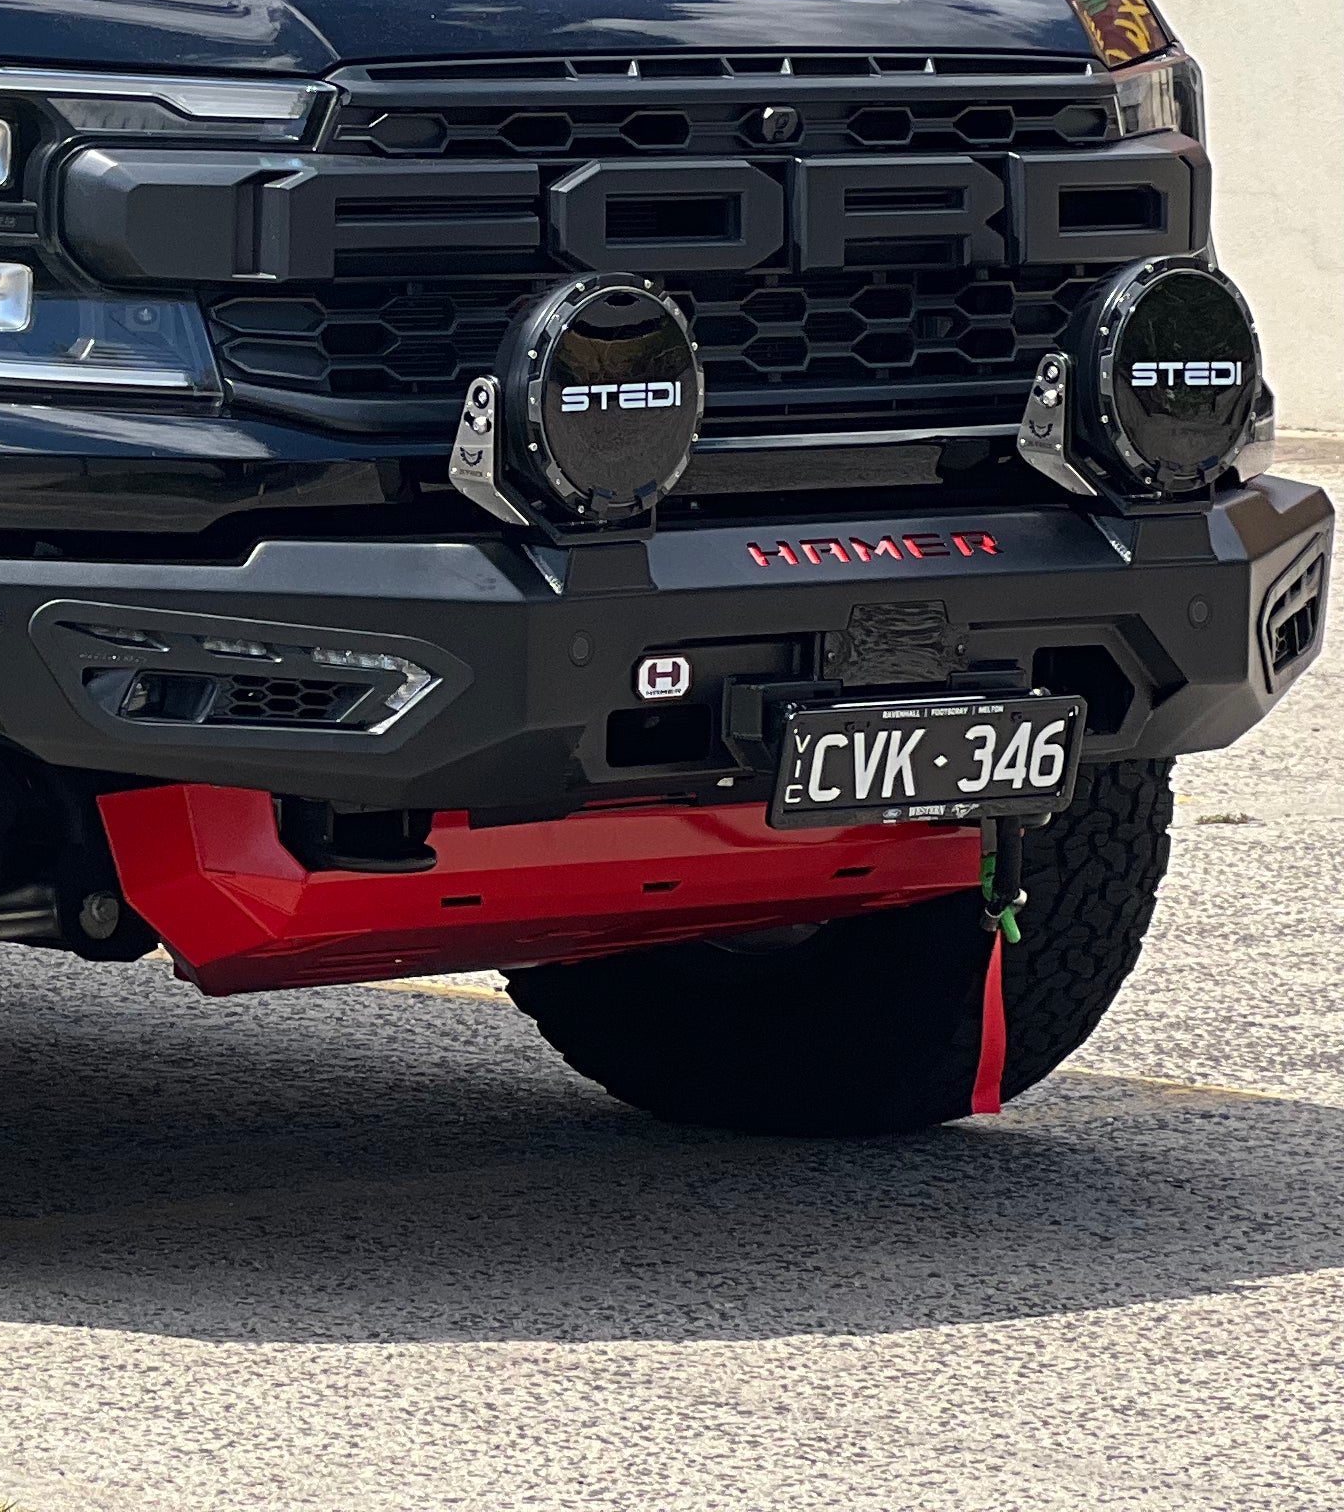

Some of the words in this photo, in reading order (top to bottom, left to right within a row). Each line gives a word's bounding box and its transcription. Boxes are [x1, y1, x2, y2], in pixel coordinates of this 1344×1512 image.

[257, 138, 1211, 283] FORD
[561, 380, 682, 412] STEDI
[1131, 361, 1242, 387] STEDI
[746, 531, 1004, 567] HAMER
[784, 733, 811, 804] VIC
[808, 728, 926, 802] CVK
[956, 719, 1066, 793] 346
